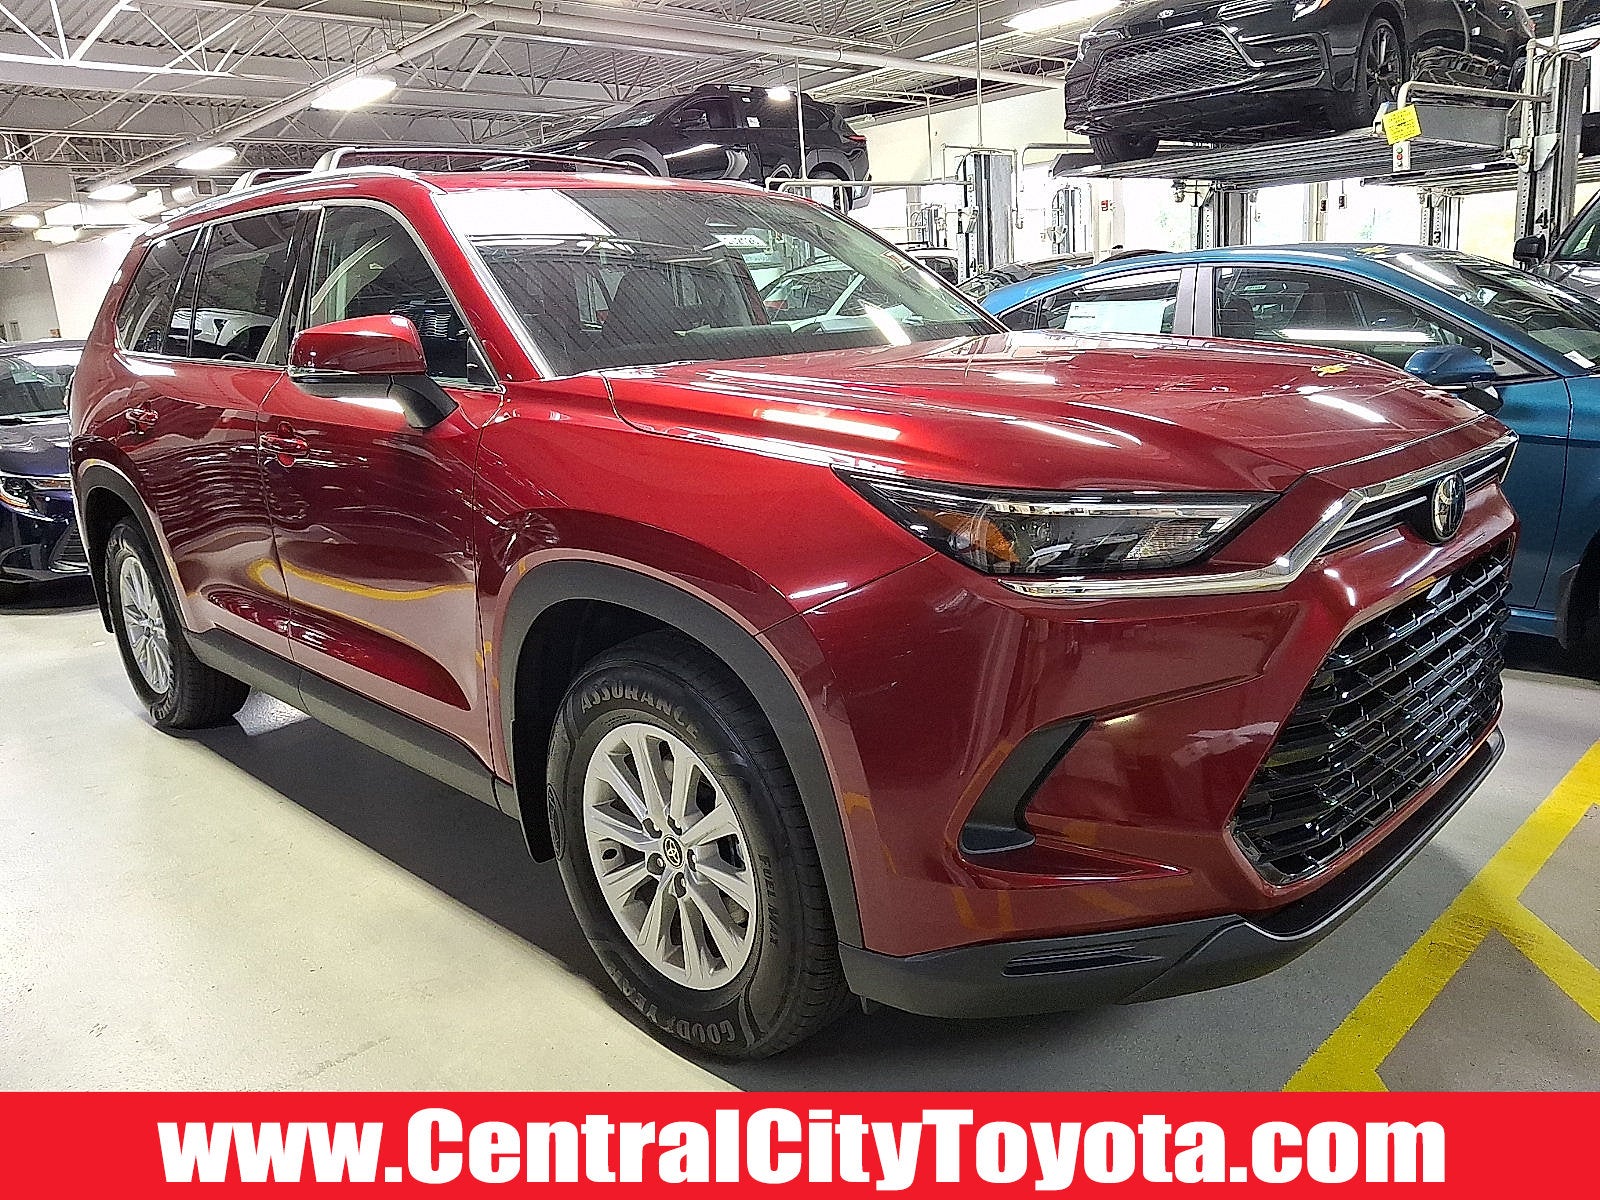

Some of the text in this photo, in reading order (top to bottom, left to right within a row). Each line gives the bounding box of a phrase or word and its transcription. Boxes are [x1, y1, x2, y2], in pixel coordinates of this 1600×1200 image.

[1433, 231, 1442, 244] 3
[1535, 209, 1549, 229] 4
[969, 257, 977, 273] 4
[579, 679, 700, 741] ASSURANCE
[758, 853, 780, 946] FUEL MAX
[604, 964, 736, 1045] GOODYEAR
